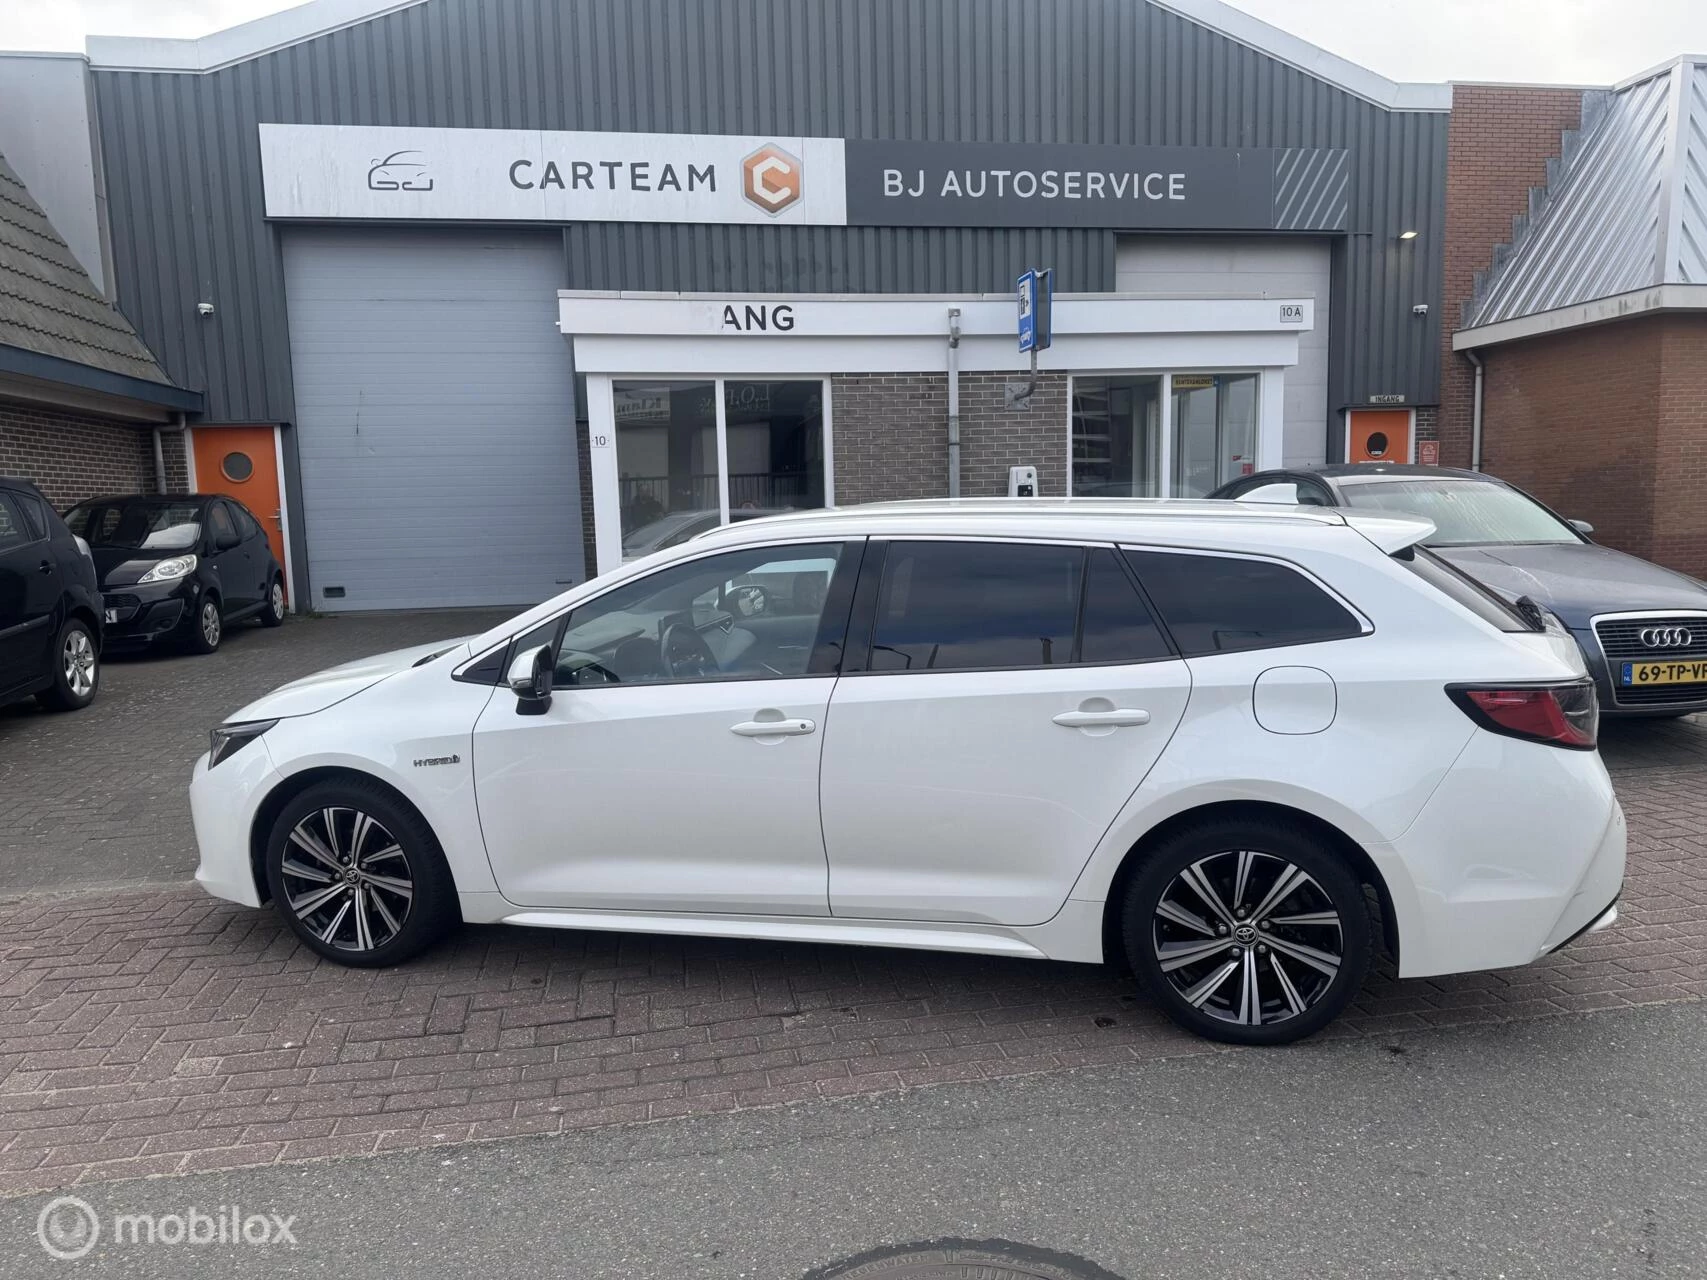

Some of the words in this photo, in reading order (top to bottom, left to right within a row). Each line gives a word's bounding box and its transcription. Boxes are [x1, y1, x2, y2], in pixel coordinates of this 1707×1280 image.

[508, 158, 718, 193] CARTEAM
[883, 168, 925, 198] BJ
[941, 169, 1187, 201] AUTOSERVICE
[722, 304, 795, 331] ANG
[1282, 307, 1293, 317] 10
[1294, 307, 1301, 317] A
[1375, 395, 1400, 403] INGANG
[594, 435, 606, 446] 10
